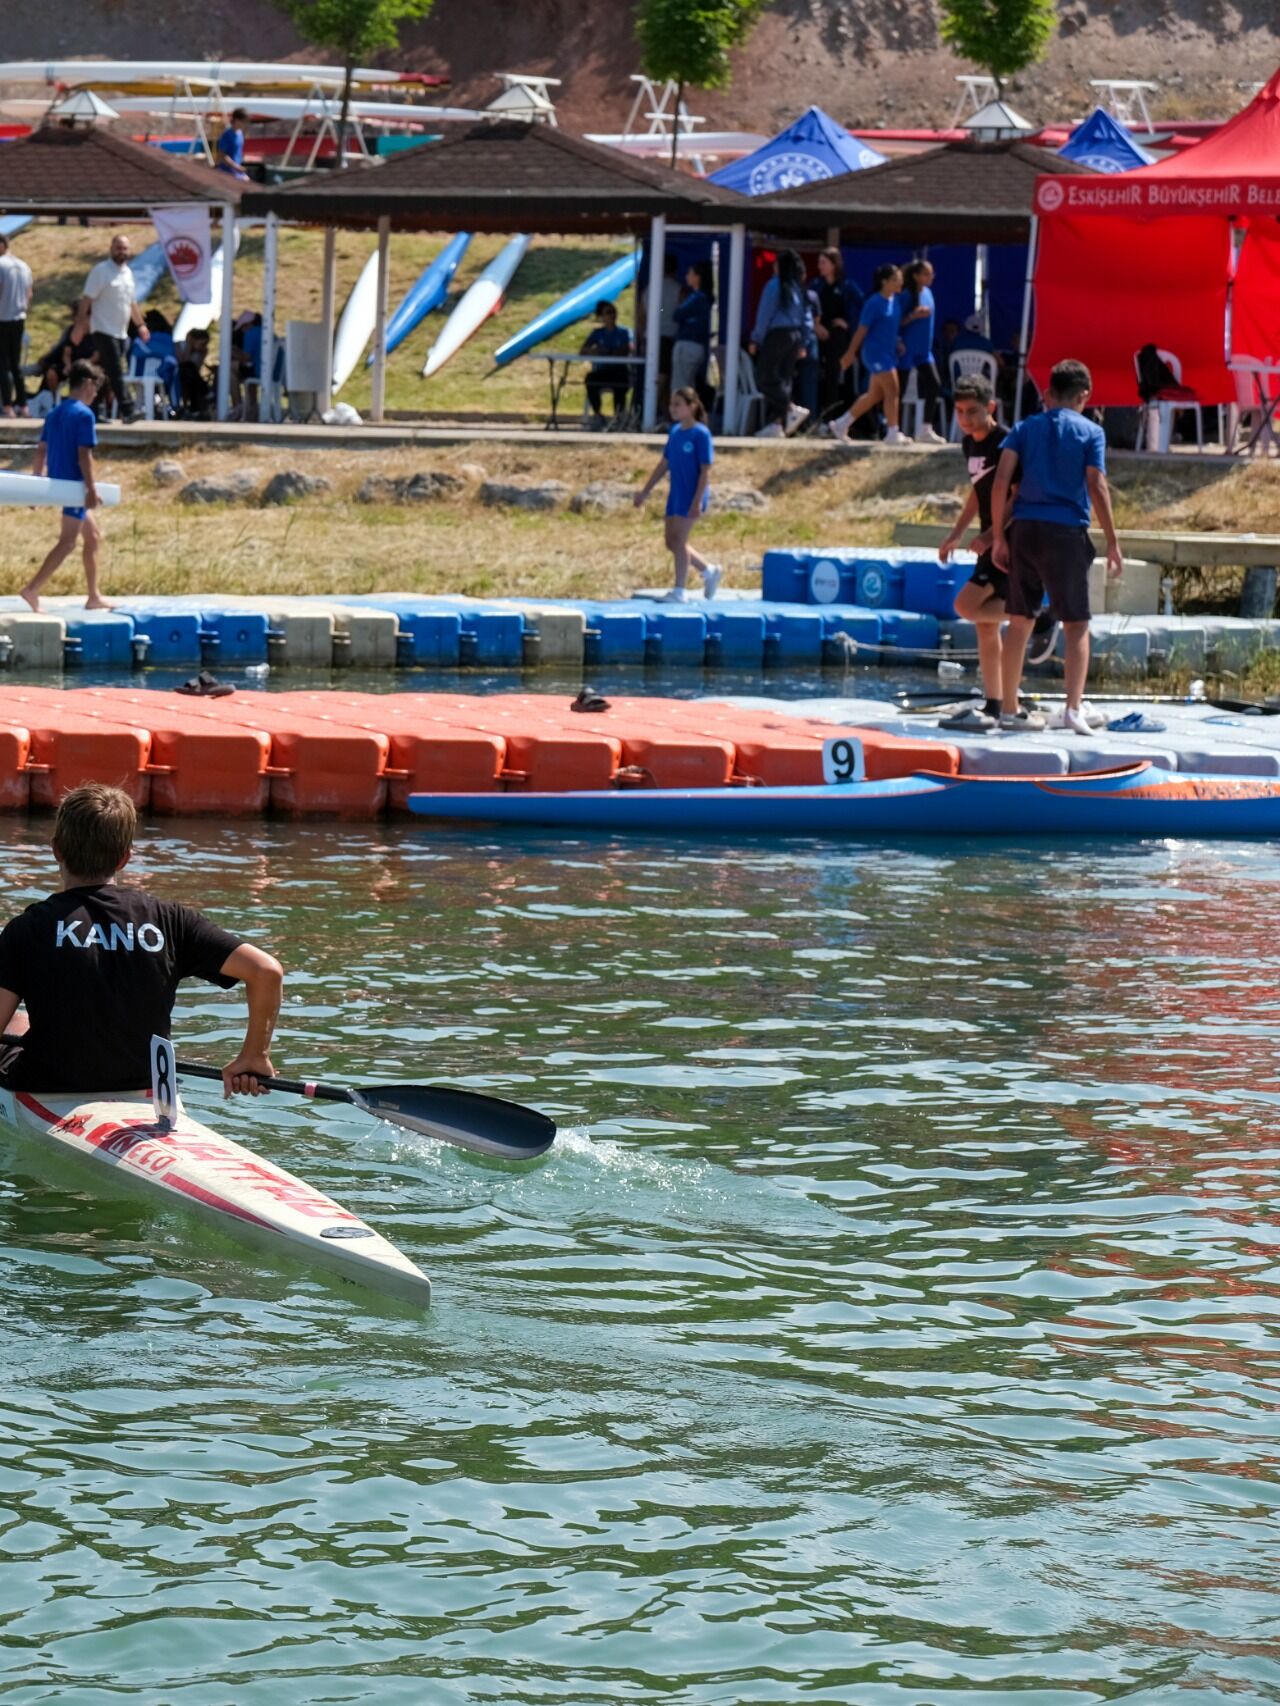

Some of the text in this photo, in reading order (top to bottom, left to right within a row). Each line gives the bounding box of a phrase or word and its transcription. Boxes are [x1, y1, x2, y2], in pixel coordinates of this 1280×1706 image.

[1148, 184, 1241, 207] BÜYÜKŞEHİR
[831, 739, 855, 779] 9
[55, 919, 165, 953] KANO
[156, 1044, 171, 1116] 8
